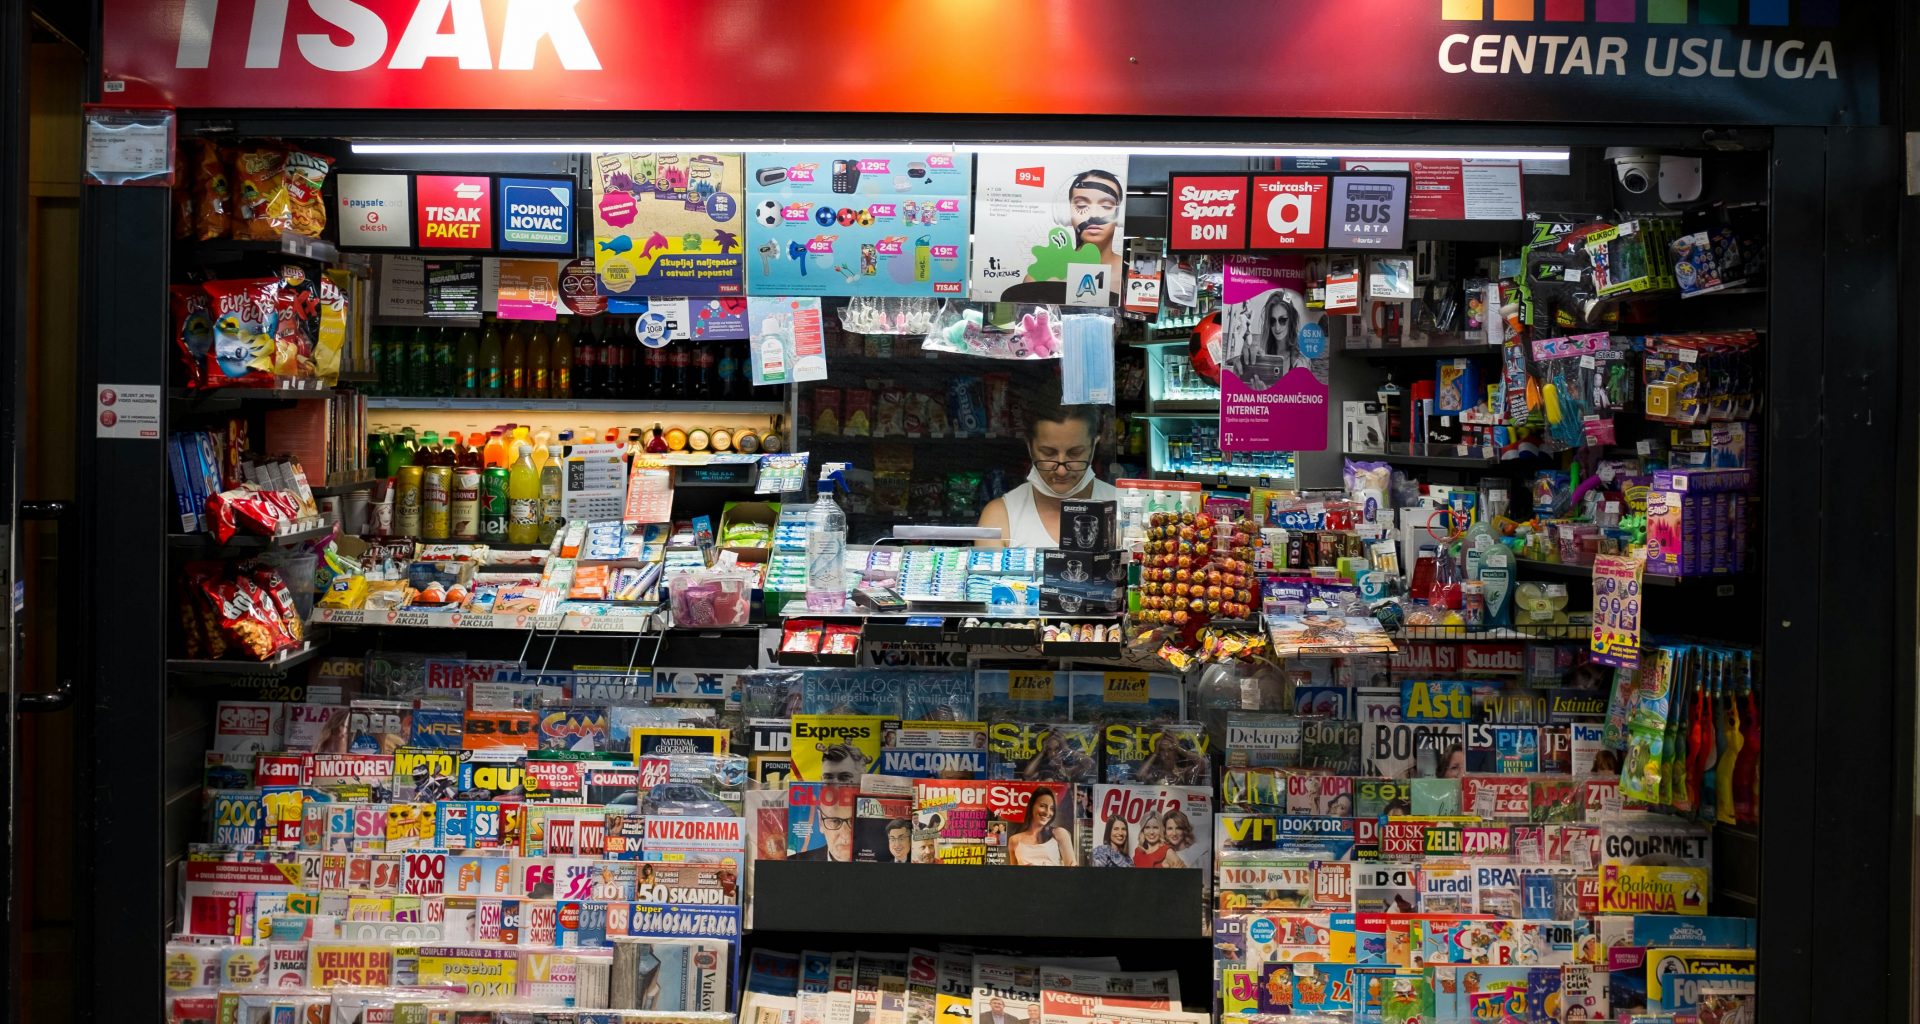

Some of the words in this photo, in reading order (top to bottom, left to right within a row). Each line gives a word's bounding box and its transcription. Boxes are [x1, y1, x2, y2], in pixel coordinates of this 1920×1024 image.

[176, 0, 602, 72] TISAK
[1438, 34, 1628, 77] CENTAR
[1644, 38, 1839, 80] USLUGA
[861, 162, 880, 170] 129
[791, 170, 804, 178] 79
[1020, 172, 1031, 180] 99
[1268, 181, 1313, 198] aircash
[1178, 186, 1240, 208] Super
[426, 207, 481, 222] TISAK
[510, 203, 563, 217] PODIGNI
[786, 210, 799, 218] 29
[872, 206, 884, 214] 14
[1180, 202, 1237, 226] Sport
[1345, 204, 1391, 224] BUS
[360, 222, 388, 232] ekesh
[510, 217, 562, 231] NOVAC
[1344, 224, 1389, 233] KARTA
[426, 224, 481, 239] PAKET
[512, 232, 530, 240] CASH
[532, 232, 562, 241] ADVANCE
[1190, 224, 1228, 241] BON
[1534, 222, 1574, 247] ZAX
[1588, 228, 1616, 242] KLIKBOT
[810, 242, 823, 250] 49
[1280, 236, 1294, 244] bon
[660, 258, 694, 268] Skupljaj
[696, 258, 737, 268] naljepnice
[989, 257, 1000, 270] ti
[666, 270, 694, 278] ostvari
[1230, 267, 1272, 278] UNLIMITED
[1540, 264, 1564, 278] ZAX
[936, 284, 959, 292] TISAK
[1076, 271, 1105, 298] A1
[1302, 330, 1312, 338] 85
[1312, 330, 1322, 338] KN
[1226, 394, 1232, 402] 7
[1233, 394, 1255, 404] DANA
[1257, 392, 1323, 404] NEOGRANIČENOG
[1226, 406, 1270, 415] INTERNETA
[1272, 588, 1304, 599] FORTNITE
[395, 618, 428, 626] AKCIJA
[458, 620, 493, 628] AKCIJA
[817, 679, 901, 695] KATALOG
[1108, 676, 1139, 692] Like
[1552, 696, 1604, 714] Istinite
[796, 723, 870, 742] Express
[656, 744, 698, 754] GEOGRAPHIC
[660, 738, 694, 747] NATIONAL
[754, 732, 791, 752] LID
[258, 757, 299, 776] kam
[396, 752, 453, 776] MOTO
[528, 764, 568, 774] auto
[884, 752, 986, 772] NACIONAL
[550, 780, 578, 790] sport
[1101, 788, 1181, 824] Gloria
[219, 801, 256, 828] 200
[648, 821, 738, 840] KVIZORAMA
[1283, 820, 1342, 832] DOKTOR
[218, 826, 255, 845] SKAND
[406, 854, 446, 880] 100
[1226, 869, 1268, 884] MOJ
[405, 880, 444, 895] SKAND
[1428, 875, 1472, 893] uradi
[1622, 875, 1674, 895] Bakina
[638, 884, 669, 904] 50
[1226, 894, 1246, 908] 20
[1602, 886, 1678, 911] KUHINJA
[636, 904, 663, 913] Super
[609, 909, 628, 930] OS
[633, 912, 737, 937] OSMOSMJERKA
[274, 950, 307, 962] VELIK
[317, 950, 365, 968] VELIKI
[420, 948, 448, 958] KOMPLET
[456, 948, 482, 958] BROJEVA
[484, 950, 493, 958] ZA
[494, 950, 502, 958] 15
[228, 964, 252, 977] 15
[443, 963, 502, 977] posebni
[912, 956, 936, 982] S
[322, 970, 363, 986] PLUS
